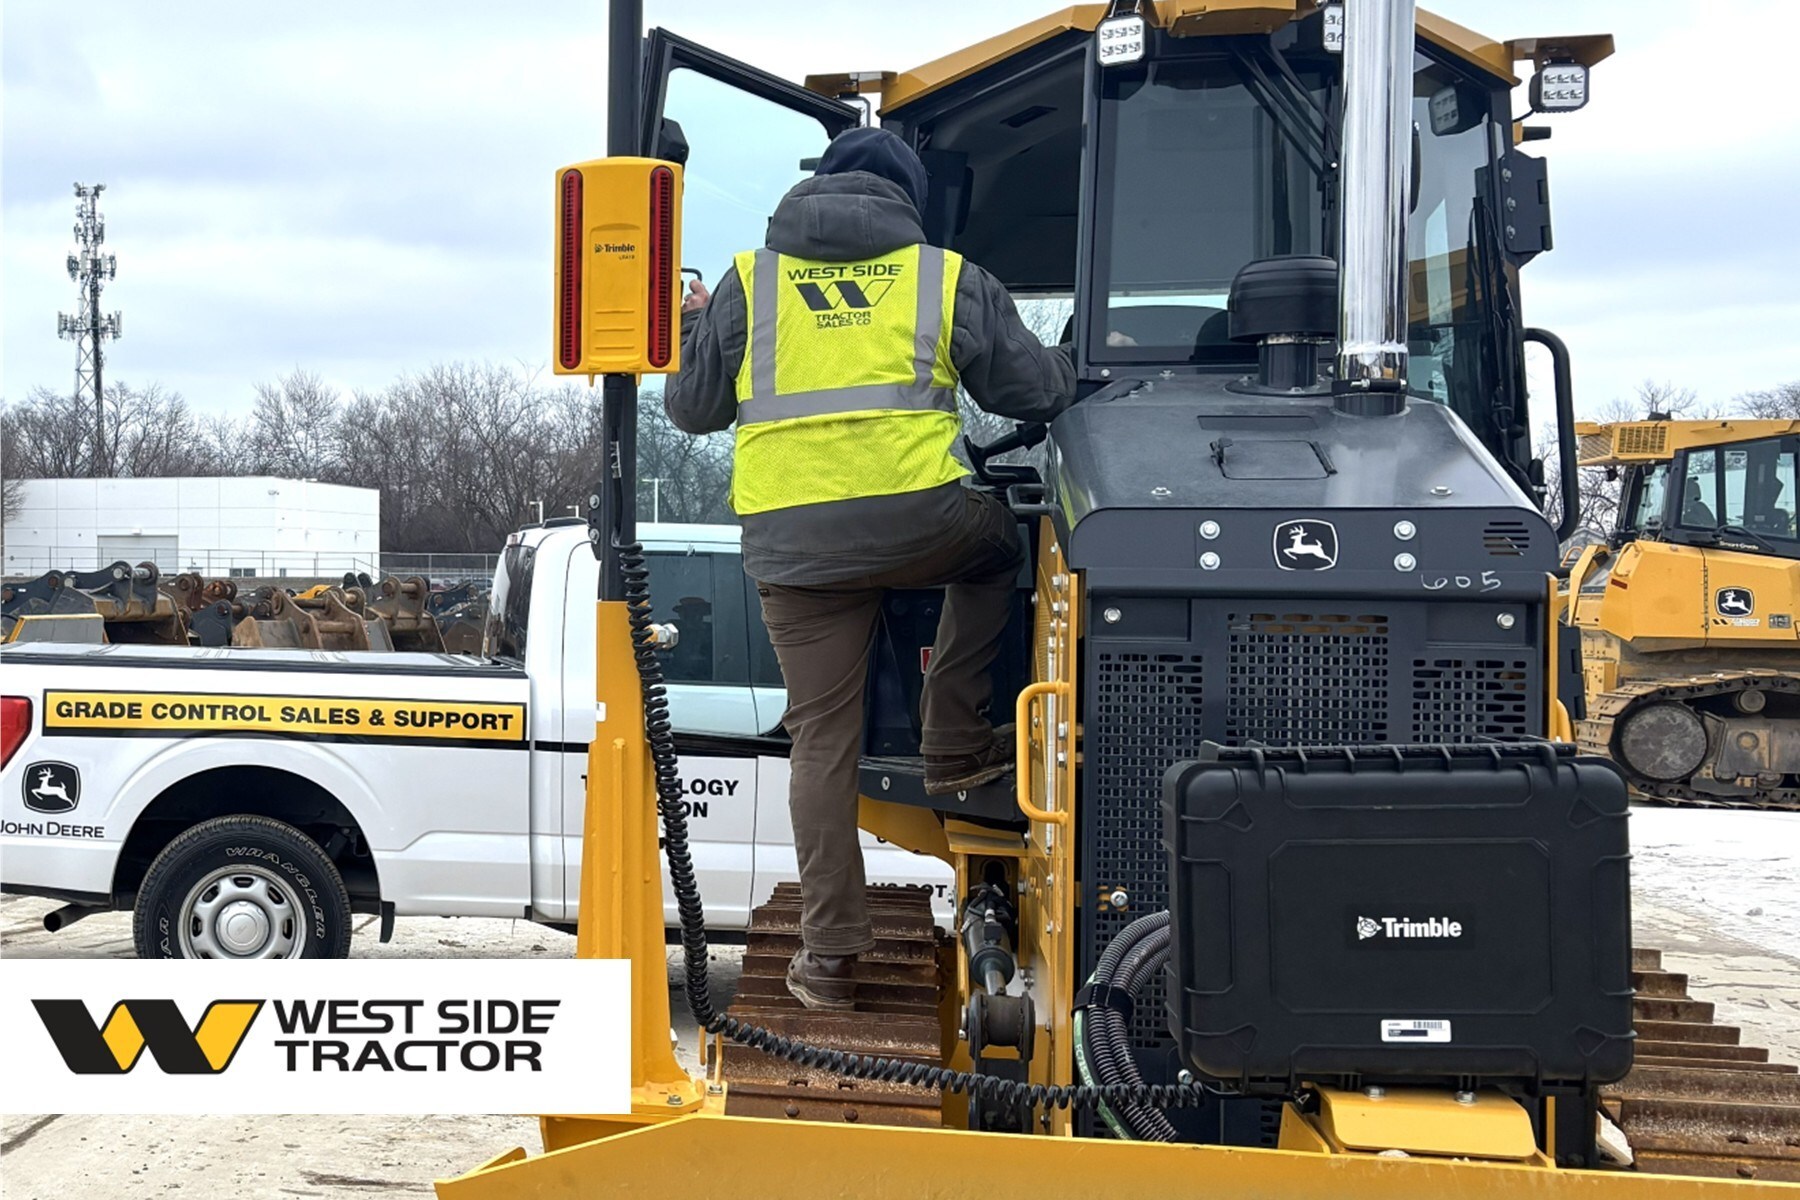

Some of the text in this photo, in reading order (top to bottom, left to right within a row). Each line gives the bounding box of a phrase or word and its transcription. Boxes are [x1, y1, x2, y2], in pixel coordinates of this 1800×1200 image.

[604, 243, 635, 253] Trimble
[787, 264, 904, 281] WEST SIDE
[815, 311, 871, 321] TRACTOR
[817, 318, 871, 329] SALES CO
[1420, 571, 1502, 593] 605
[56, 701, 514, 731] GRADE CONTROL SALES & SUPPORT
[0, 820, 105, 838] JOHN DEERE
[225, 847, 325, 940] WRANGLER
[1381, 916, 1462, 938] Trimble
[159, 917, 173, 959] AR
